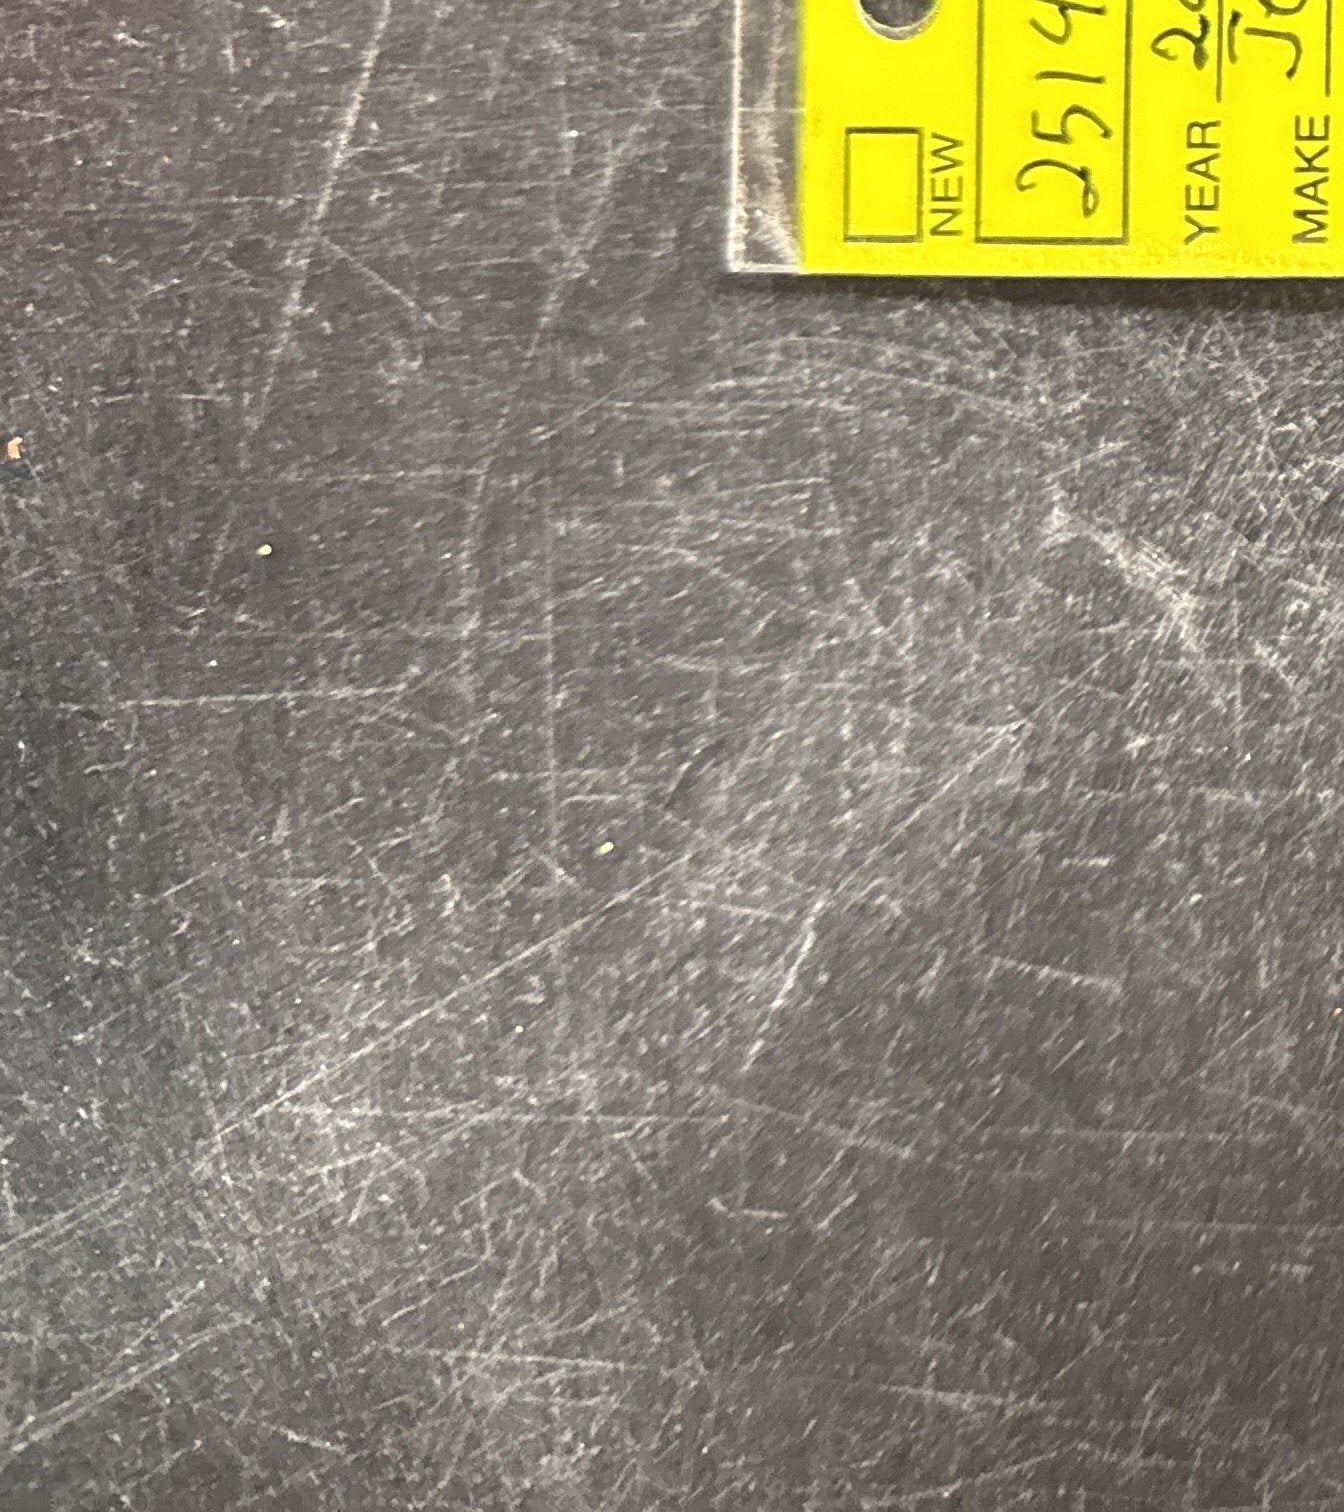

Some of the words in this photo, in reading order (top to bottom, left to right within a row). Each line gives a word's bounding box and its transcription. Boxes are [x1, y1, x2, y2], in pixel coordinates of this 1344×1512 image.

[930, 131, 964, 236] NEW
[1184, 119, 1222, 245] YEAR
[1292, 113, 1331, 244] MAKE
